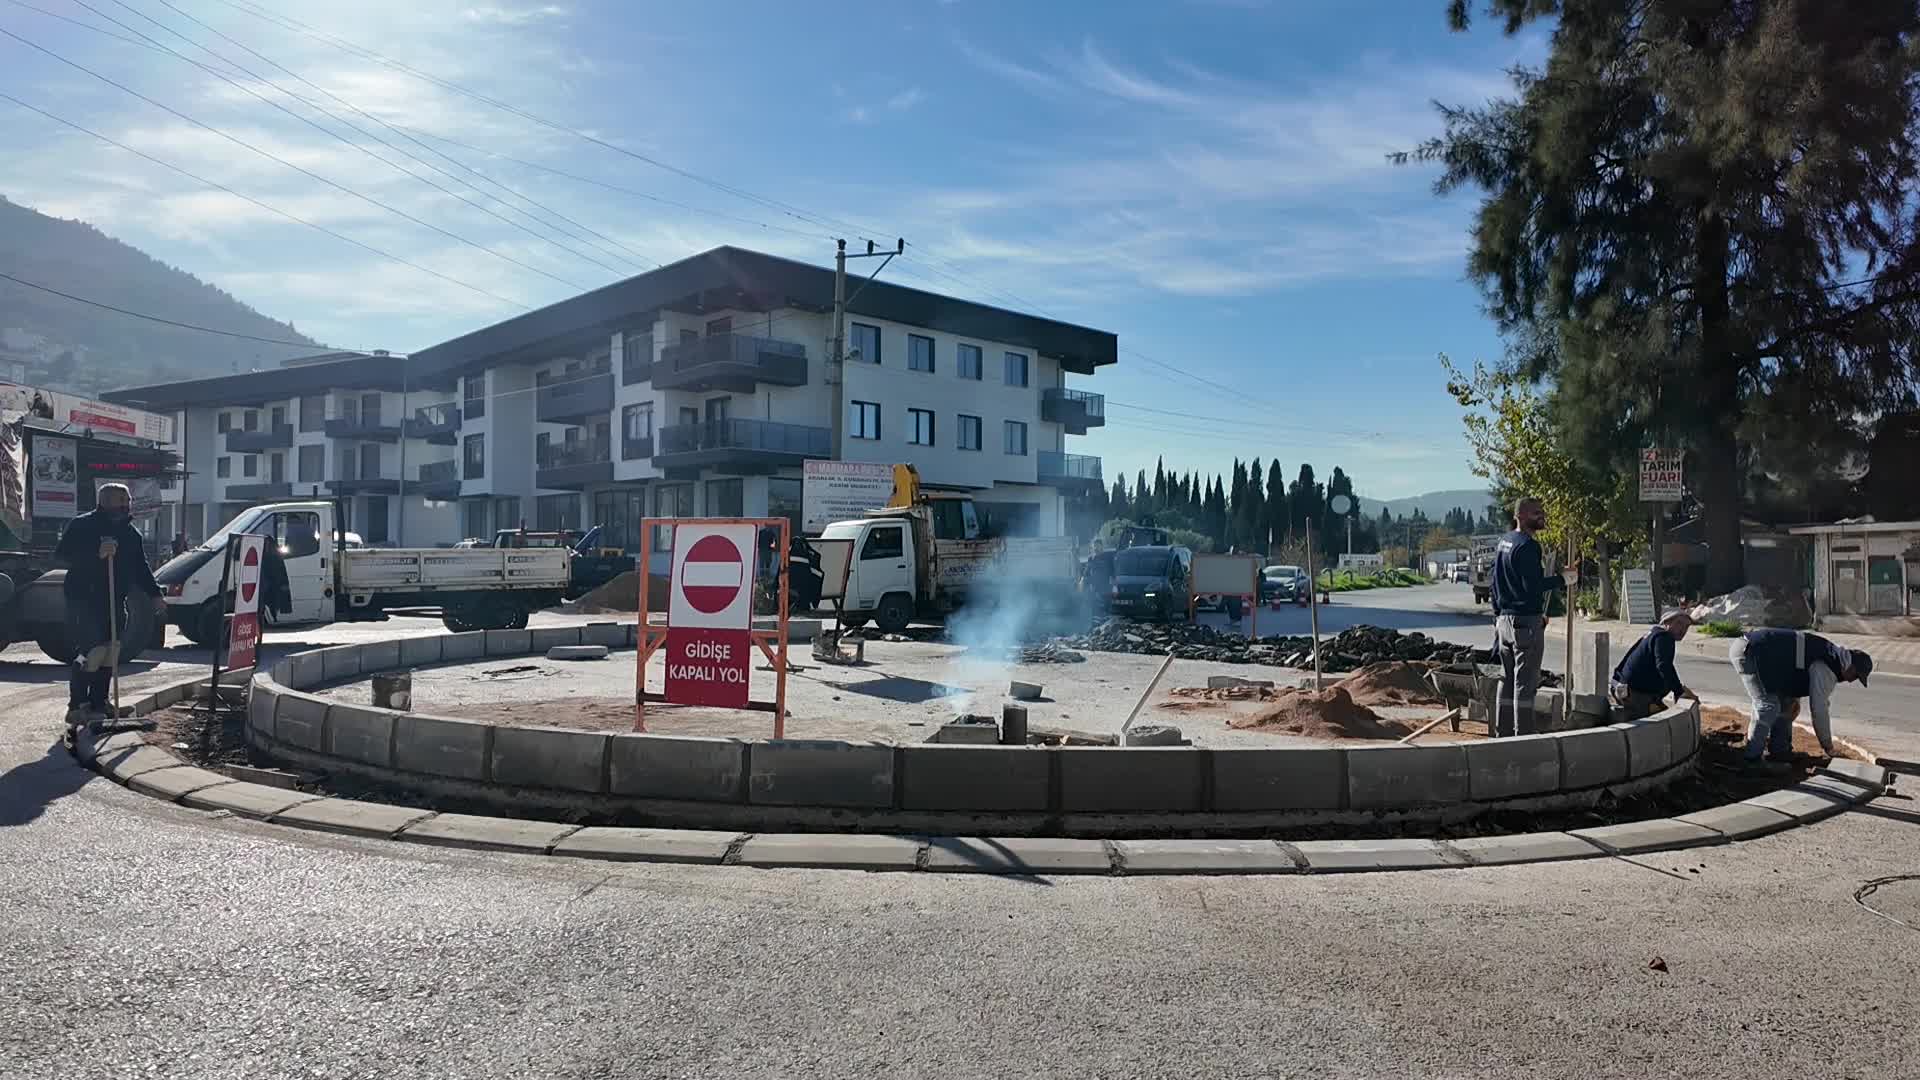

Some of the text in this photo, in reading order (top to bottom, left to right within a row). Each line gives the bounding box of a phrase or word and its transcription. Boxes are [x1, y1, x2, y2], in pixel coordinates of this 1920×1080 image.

[1641, 461, 1680, 471] TARIM
[1641, 472, 1680, 482] FUARI
[685, 640, 731, 663] GİDİŞE
[669, 664, 746, 683] KAPALI YOL
